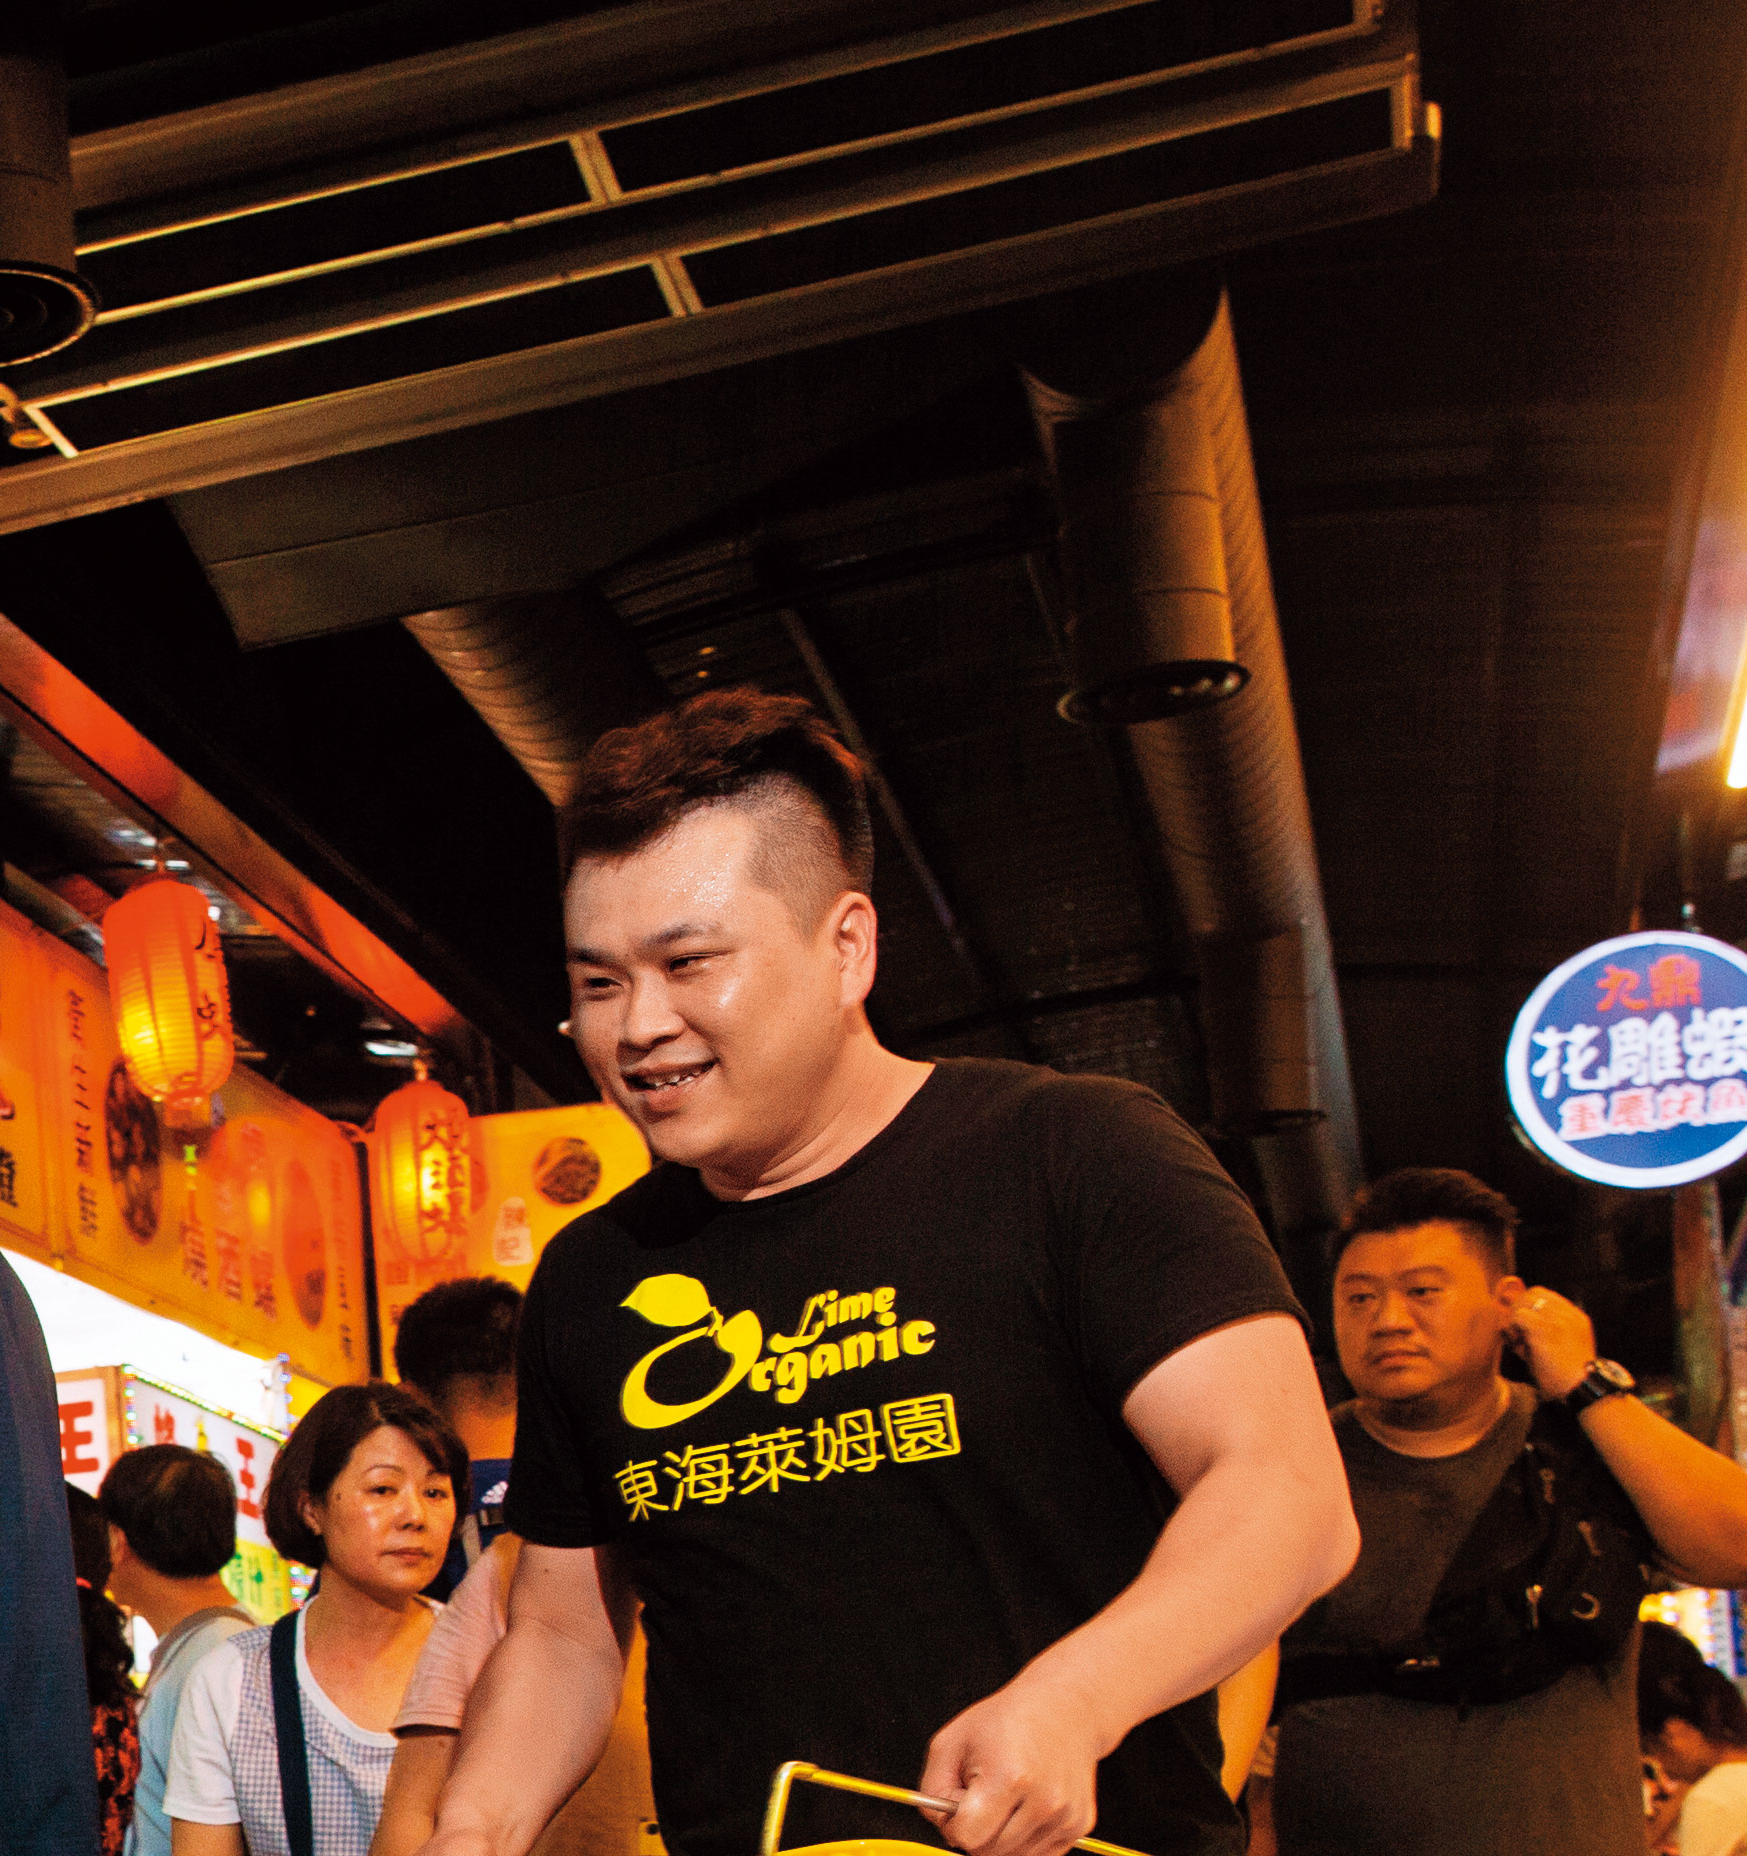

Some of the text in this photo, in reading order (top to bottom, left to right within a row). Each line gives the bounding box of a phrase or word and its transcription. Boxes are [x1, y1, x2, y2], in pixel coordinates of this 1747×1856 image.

[770, 1286, 897, 1353] Lime
[612, 1392, 962, 1523] 東海萊姆園
